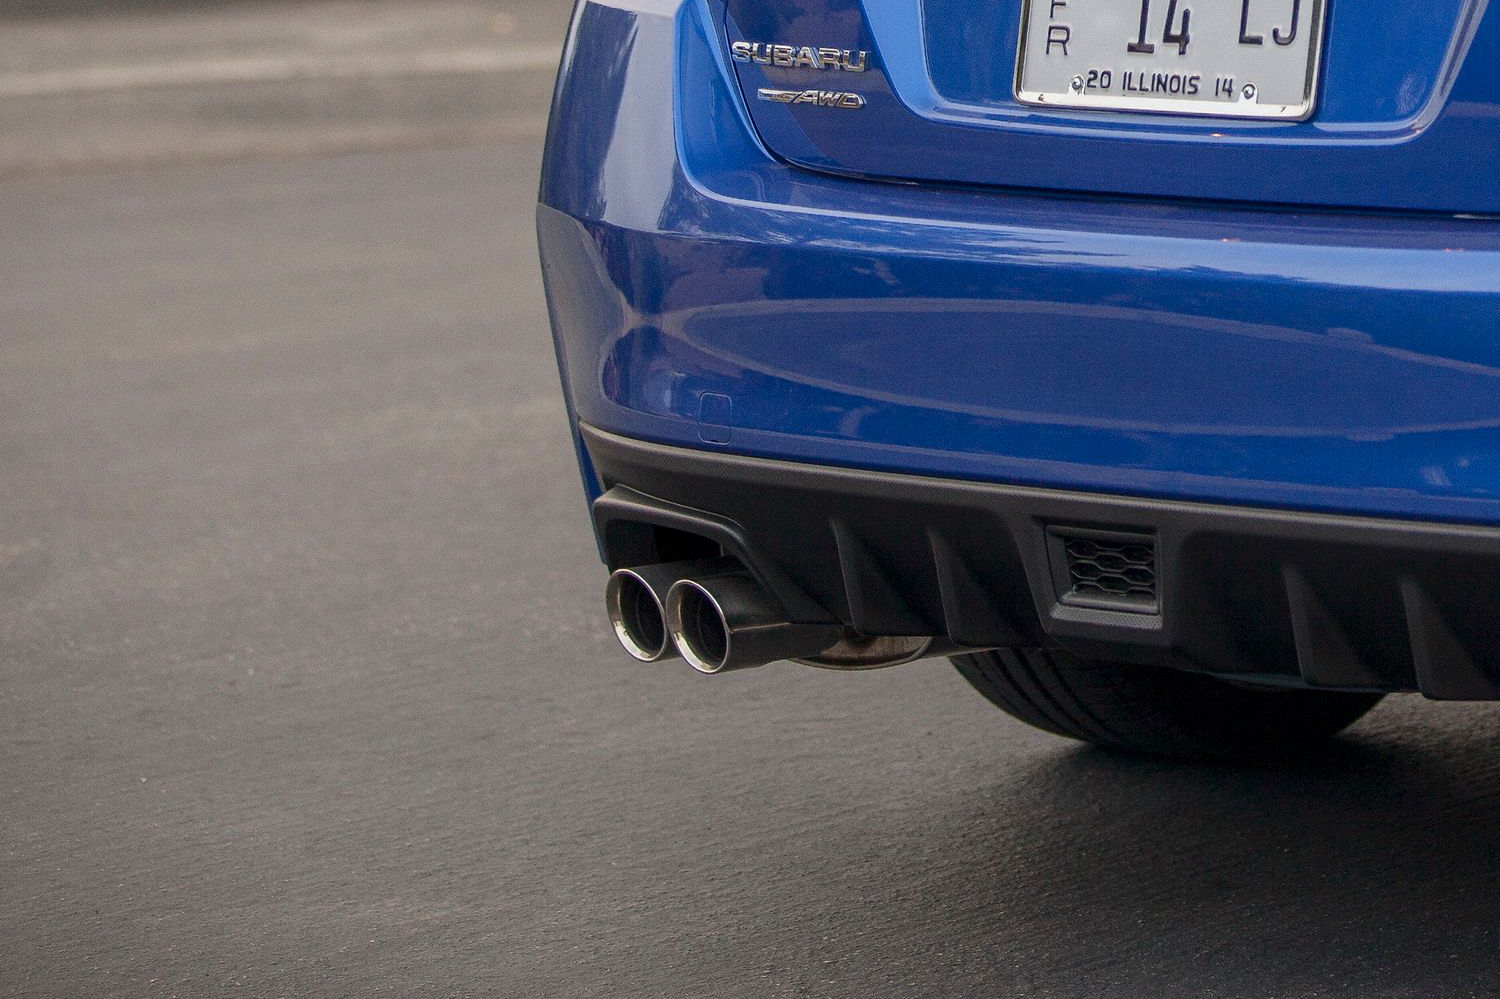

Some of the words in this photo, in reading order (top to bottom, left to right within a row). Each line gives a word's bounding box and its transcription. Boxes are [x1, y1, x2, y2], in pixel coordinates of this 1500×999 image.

[732, 41, 867, 72] SUBARU
[1086, 69, 1112, 90] 20
[1122, 70, 1201, 95] ILLINOIS
[1215, 77, 1234, 98] 14
[793, 90, 866, 109] AWD
